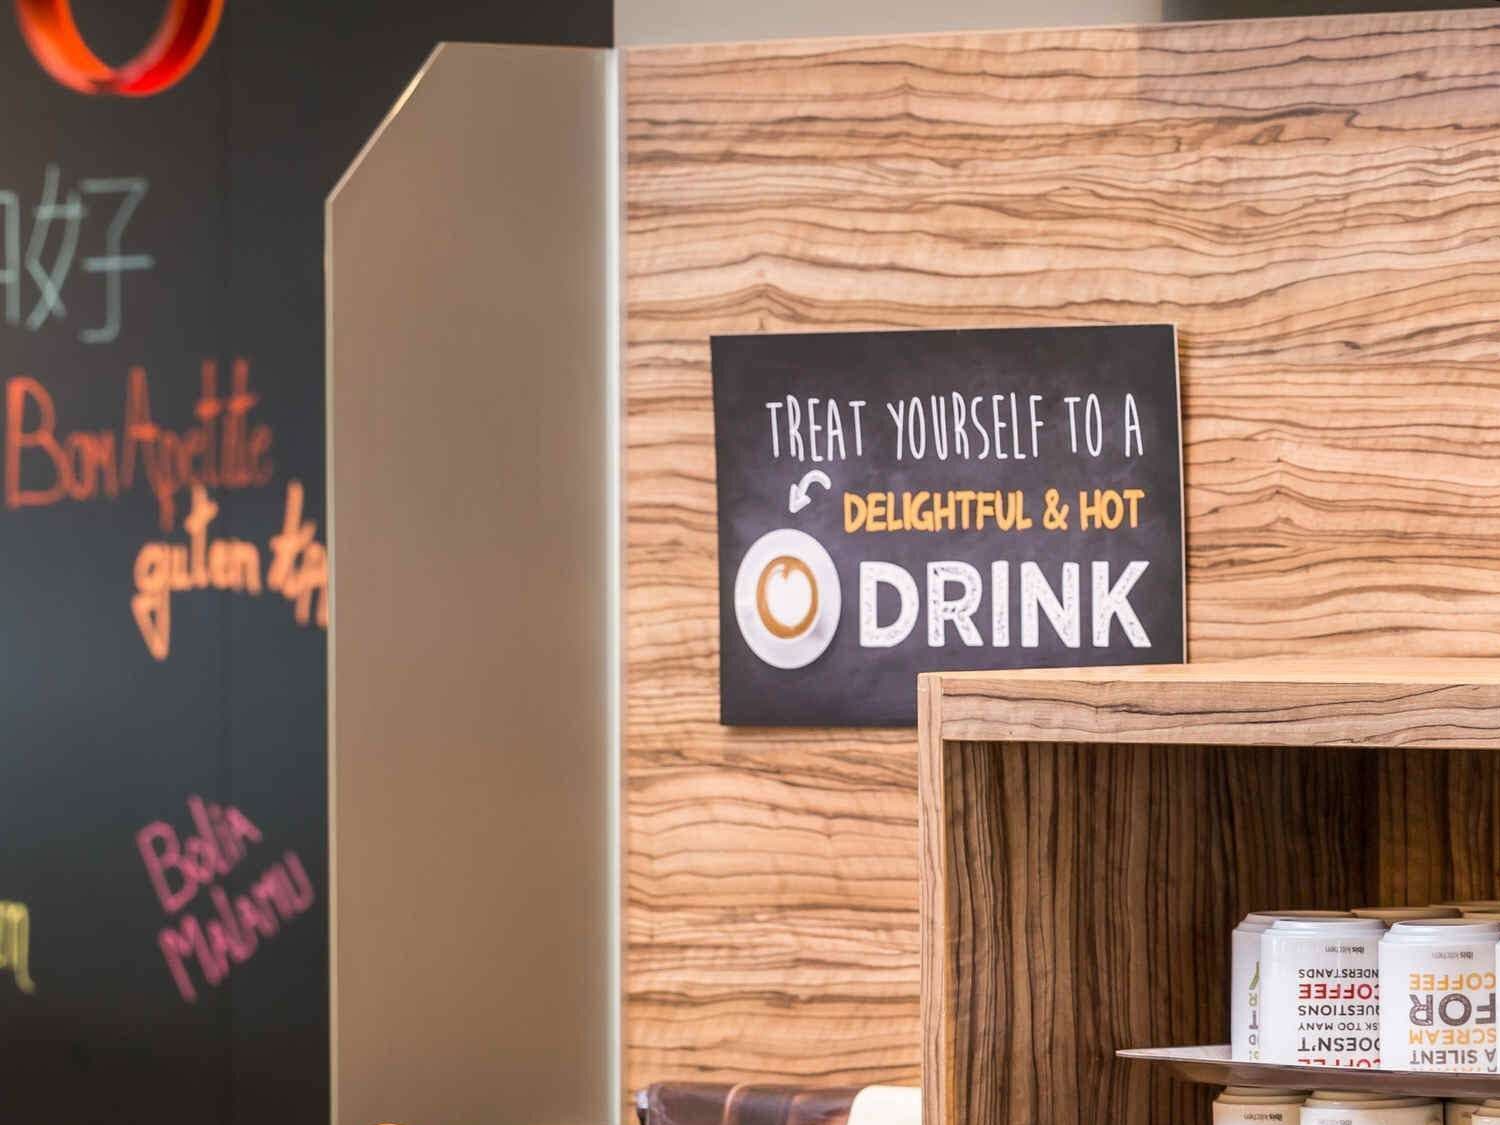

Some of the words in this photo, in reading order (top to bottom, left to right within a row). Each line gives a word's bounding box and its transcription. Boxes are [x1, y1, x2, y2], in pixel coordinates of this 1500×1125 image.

[766, 395, 866, 462] TREAT
[887, 391, 1043, 460] YOURSELF
[1064, 396, 1102, 457] TO
[1124, 392, 1144, 458] A
[843, 490, 1032, 534] DELIGHTFUL
[1043, 488, 1070, 530] &
[1079, 488, 1145, 530] HOT
[858, 560, 1152, 649] DRINK
[1409, 972, 1497, 990] COFFEE
[1409, 993, 1497, 1026] FOR
[1409, 1028, 1497, 1045] SCREAM
[1409, 1050, 1478, 1066] SILENT
[1485, 1048, 1497, 1063] A
